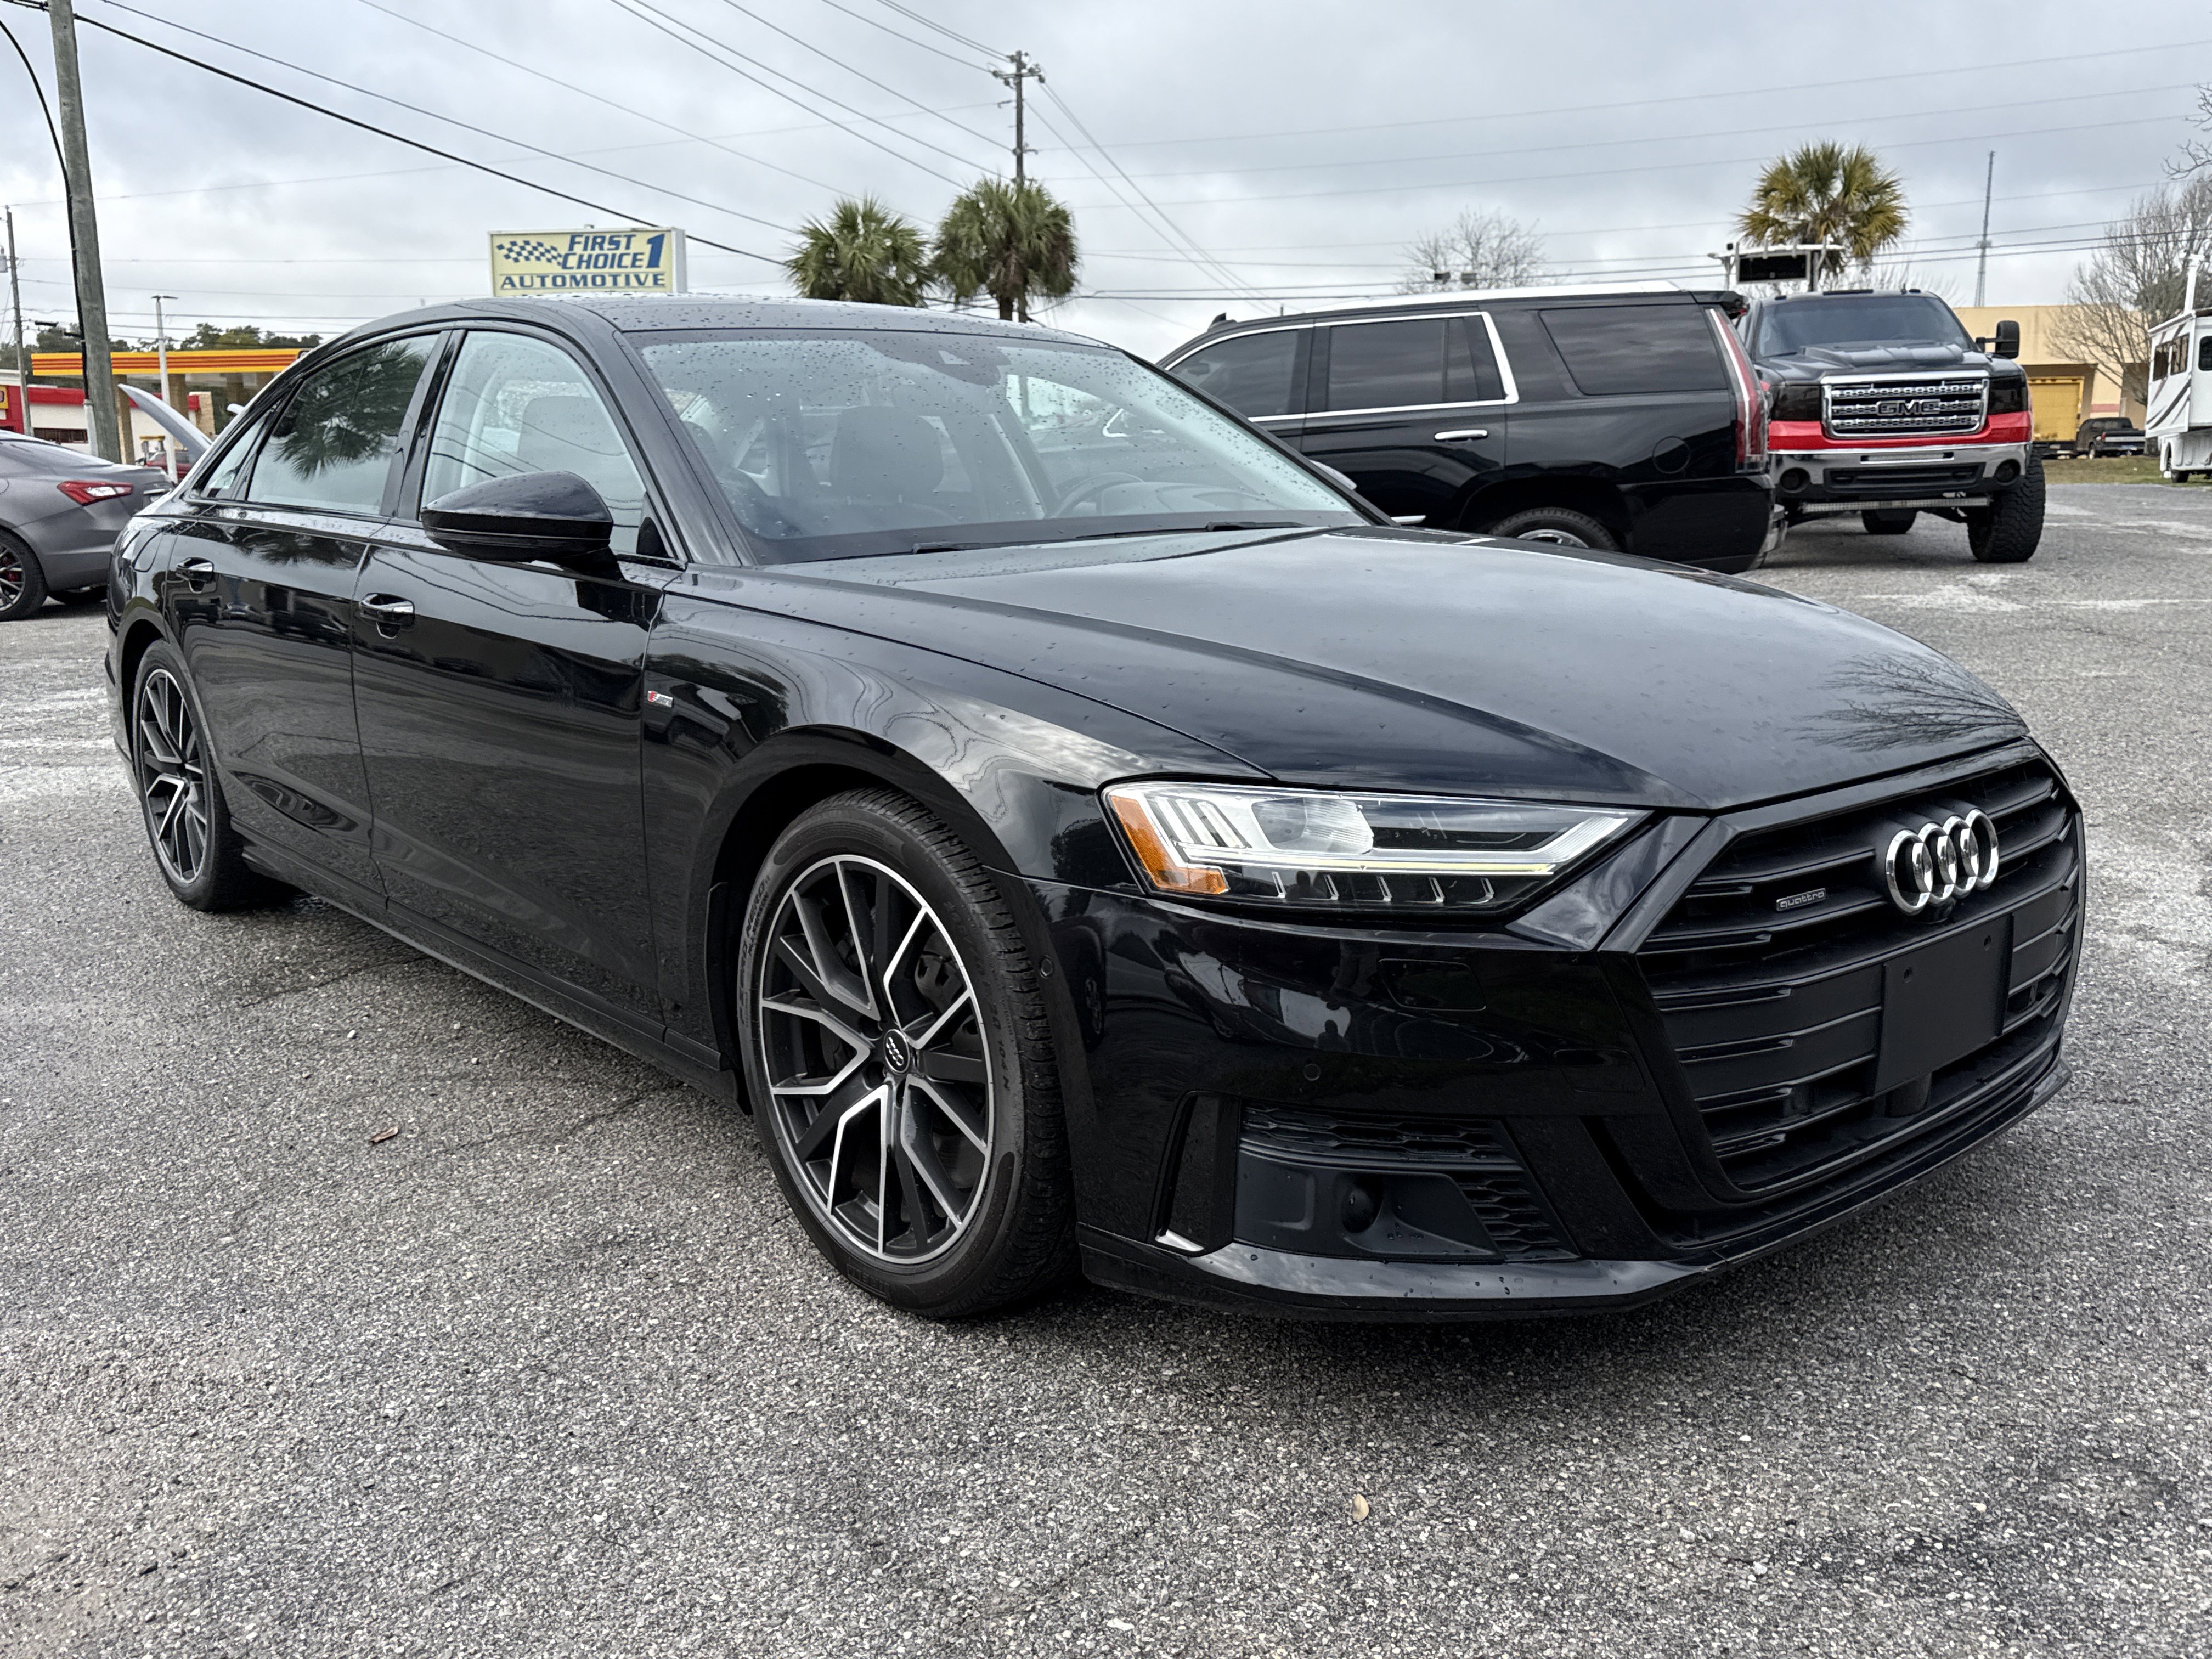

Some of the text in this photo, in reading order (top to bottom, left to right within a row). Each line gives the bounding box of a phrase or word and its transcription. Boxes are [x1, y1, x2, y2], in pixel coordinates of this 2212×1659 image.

[562, 234, 665, 269] CHOICE 1
[568, 235, 636, 251] FIRST
[501, 274, 665, 289] AUTOMOTIVE
[1876, 399, 1940, 416] GMC
[1780, 891, 1825, 909] quattro
